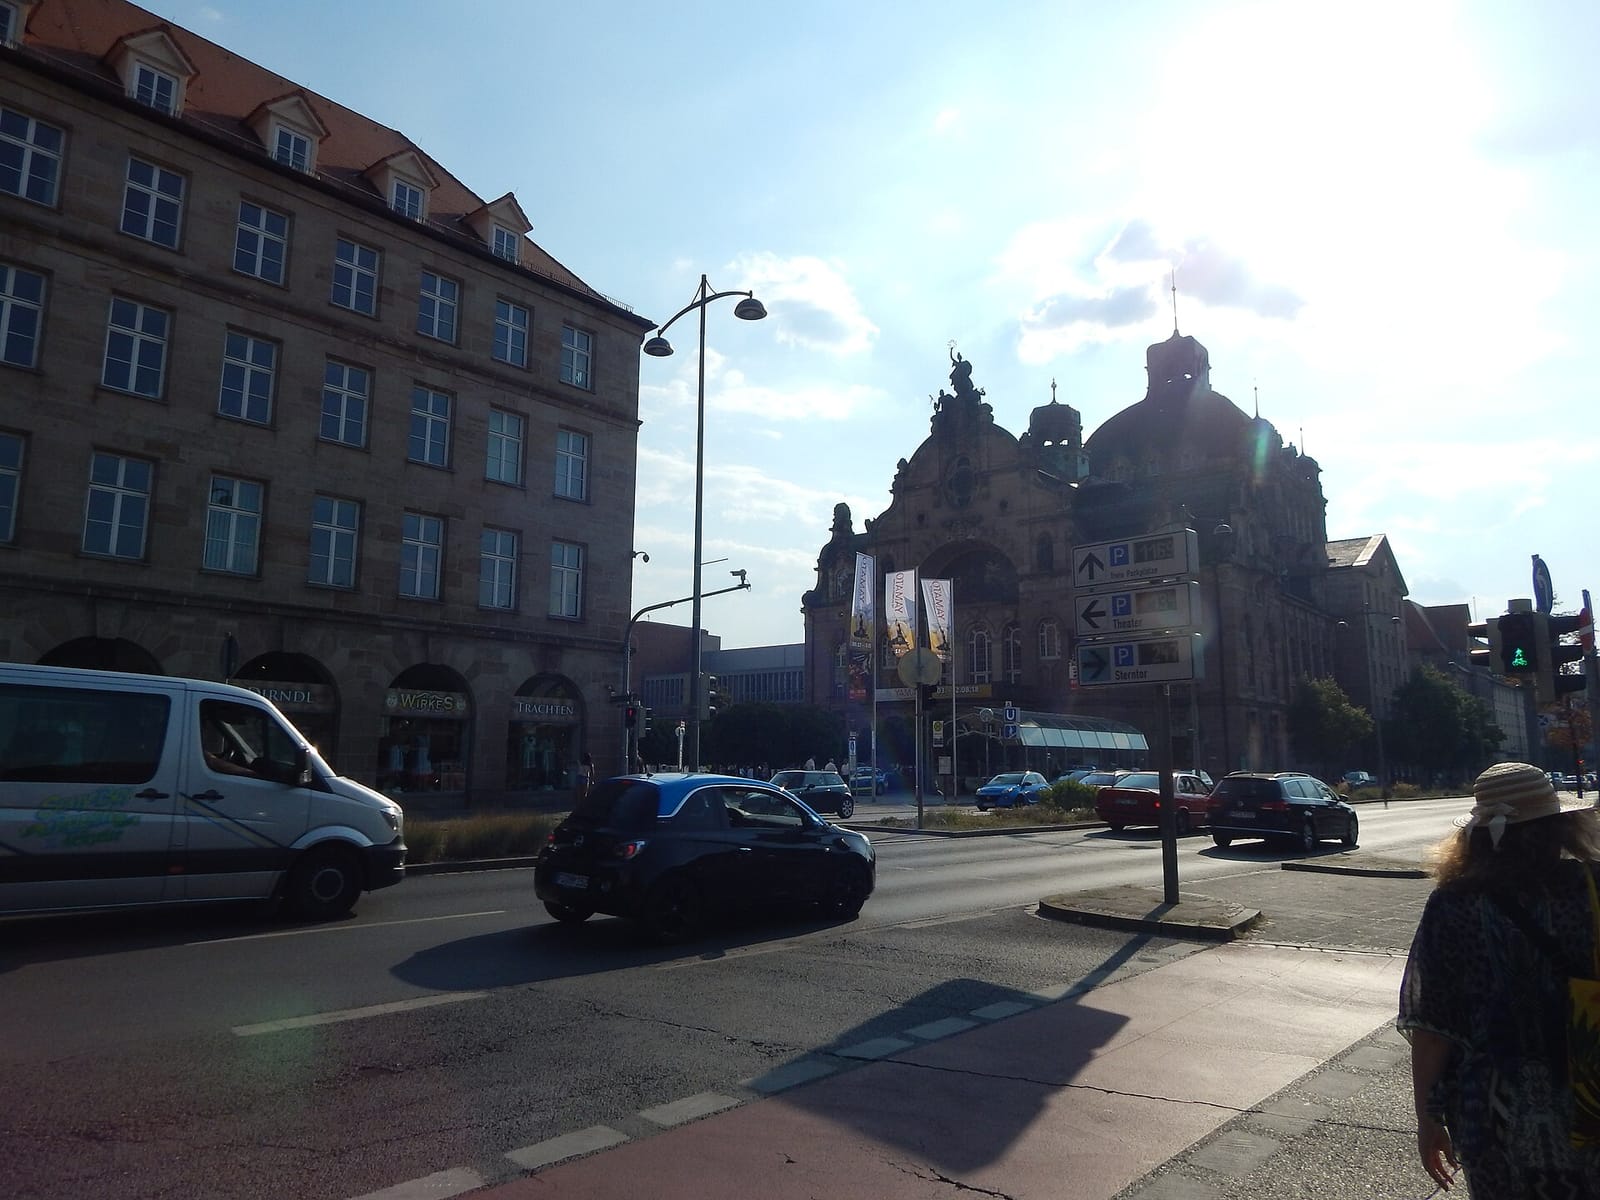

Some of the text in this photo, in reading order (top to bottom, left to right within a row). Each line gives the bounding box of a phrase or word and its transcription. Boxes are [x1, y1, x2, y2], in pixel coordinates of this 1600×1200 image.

[1112, 617, 1143, 630] Theater
[1114, 668, 1149, 682] Sterntor
[518, 702, 574, 716] TRACHTEN
